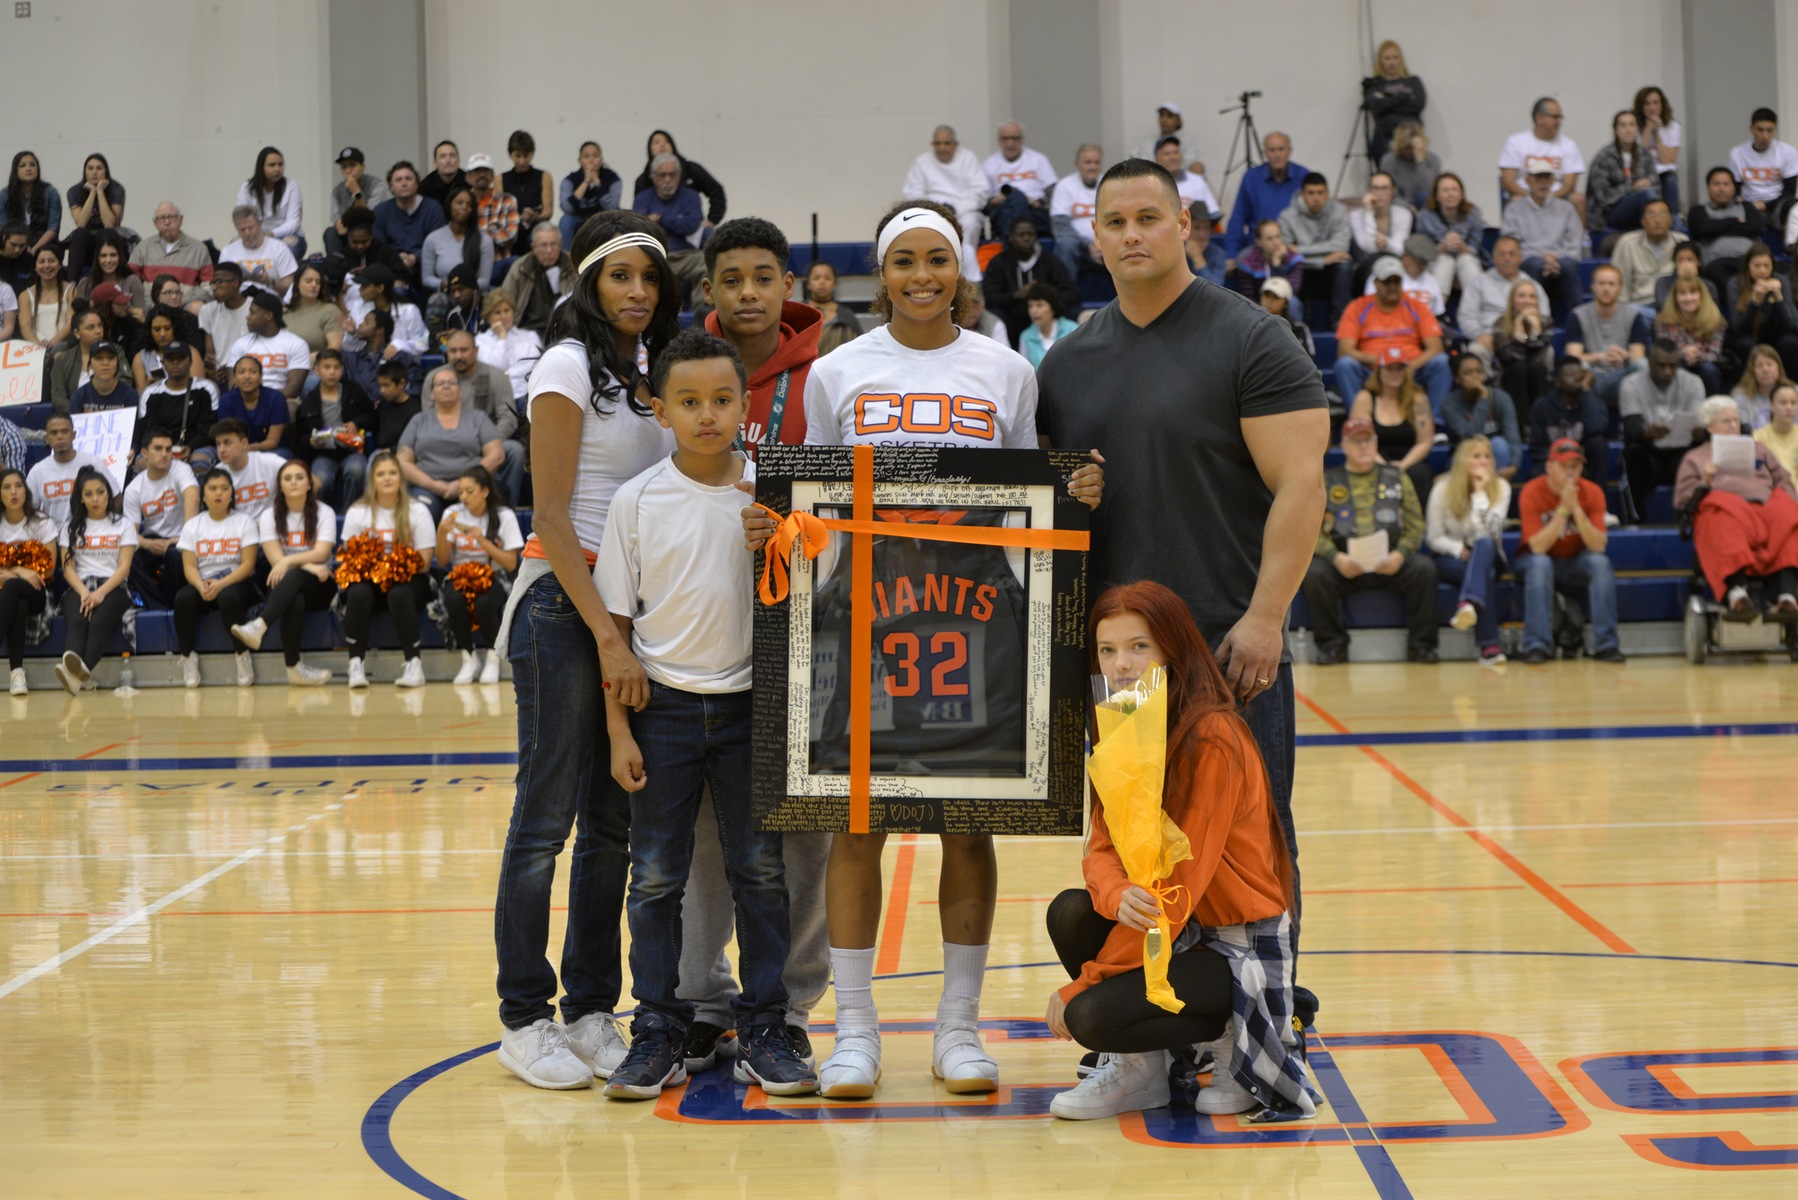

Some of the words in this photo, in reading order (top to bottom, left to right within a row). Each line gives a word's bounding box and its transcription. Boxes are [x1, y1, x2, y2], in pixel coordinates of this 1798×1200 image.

[854, 393, 997, 440] COS
[43, 479, 77, 499] CO
[236, 481, 270, 505] OS
[196, 537, 241, 557] COS
[849, 573, 998, 622] IANTS
[883, 631, 969, 696] 32
